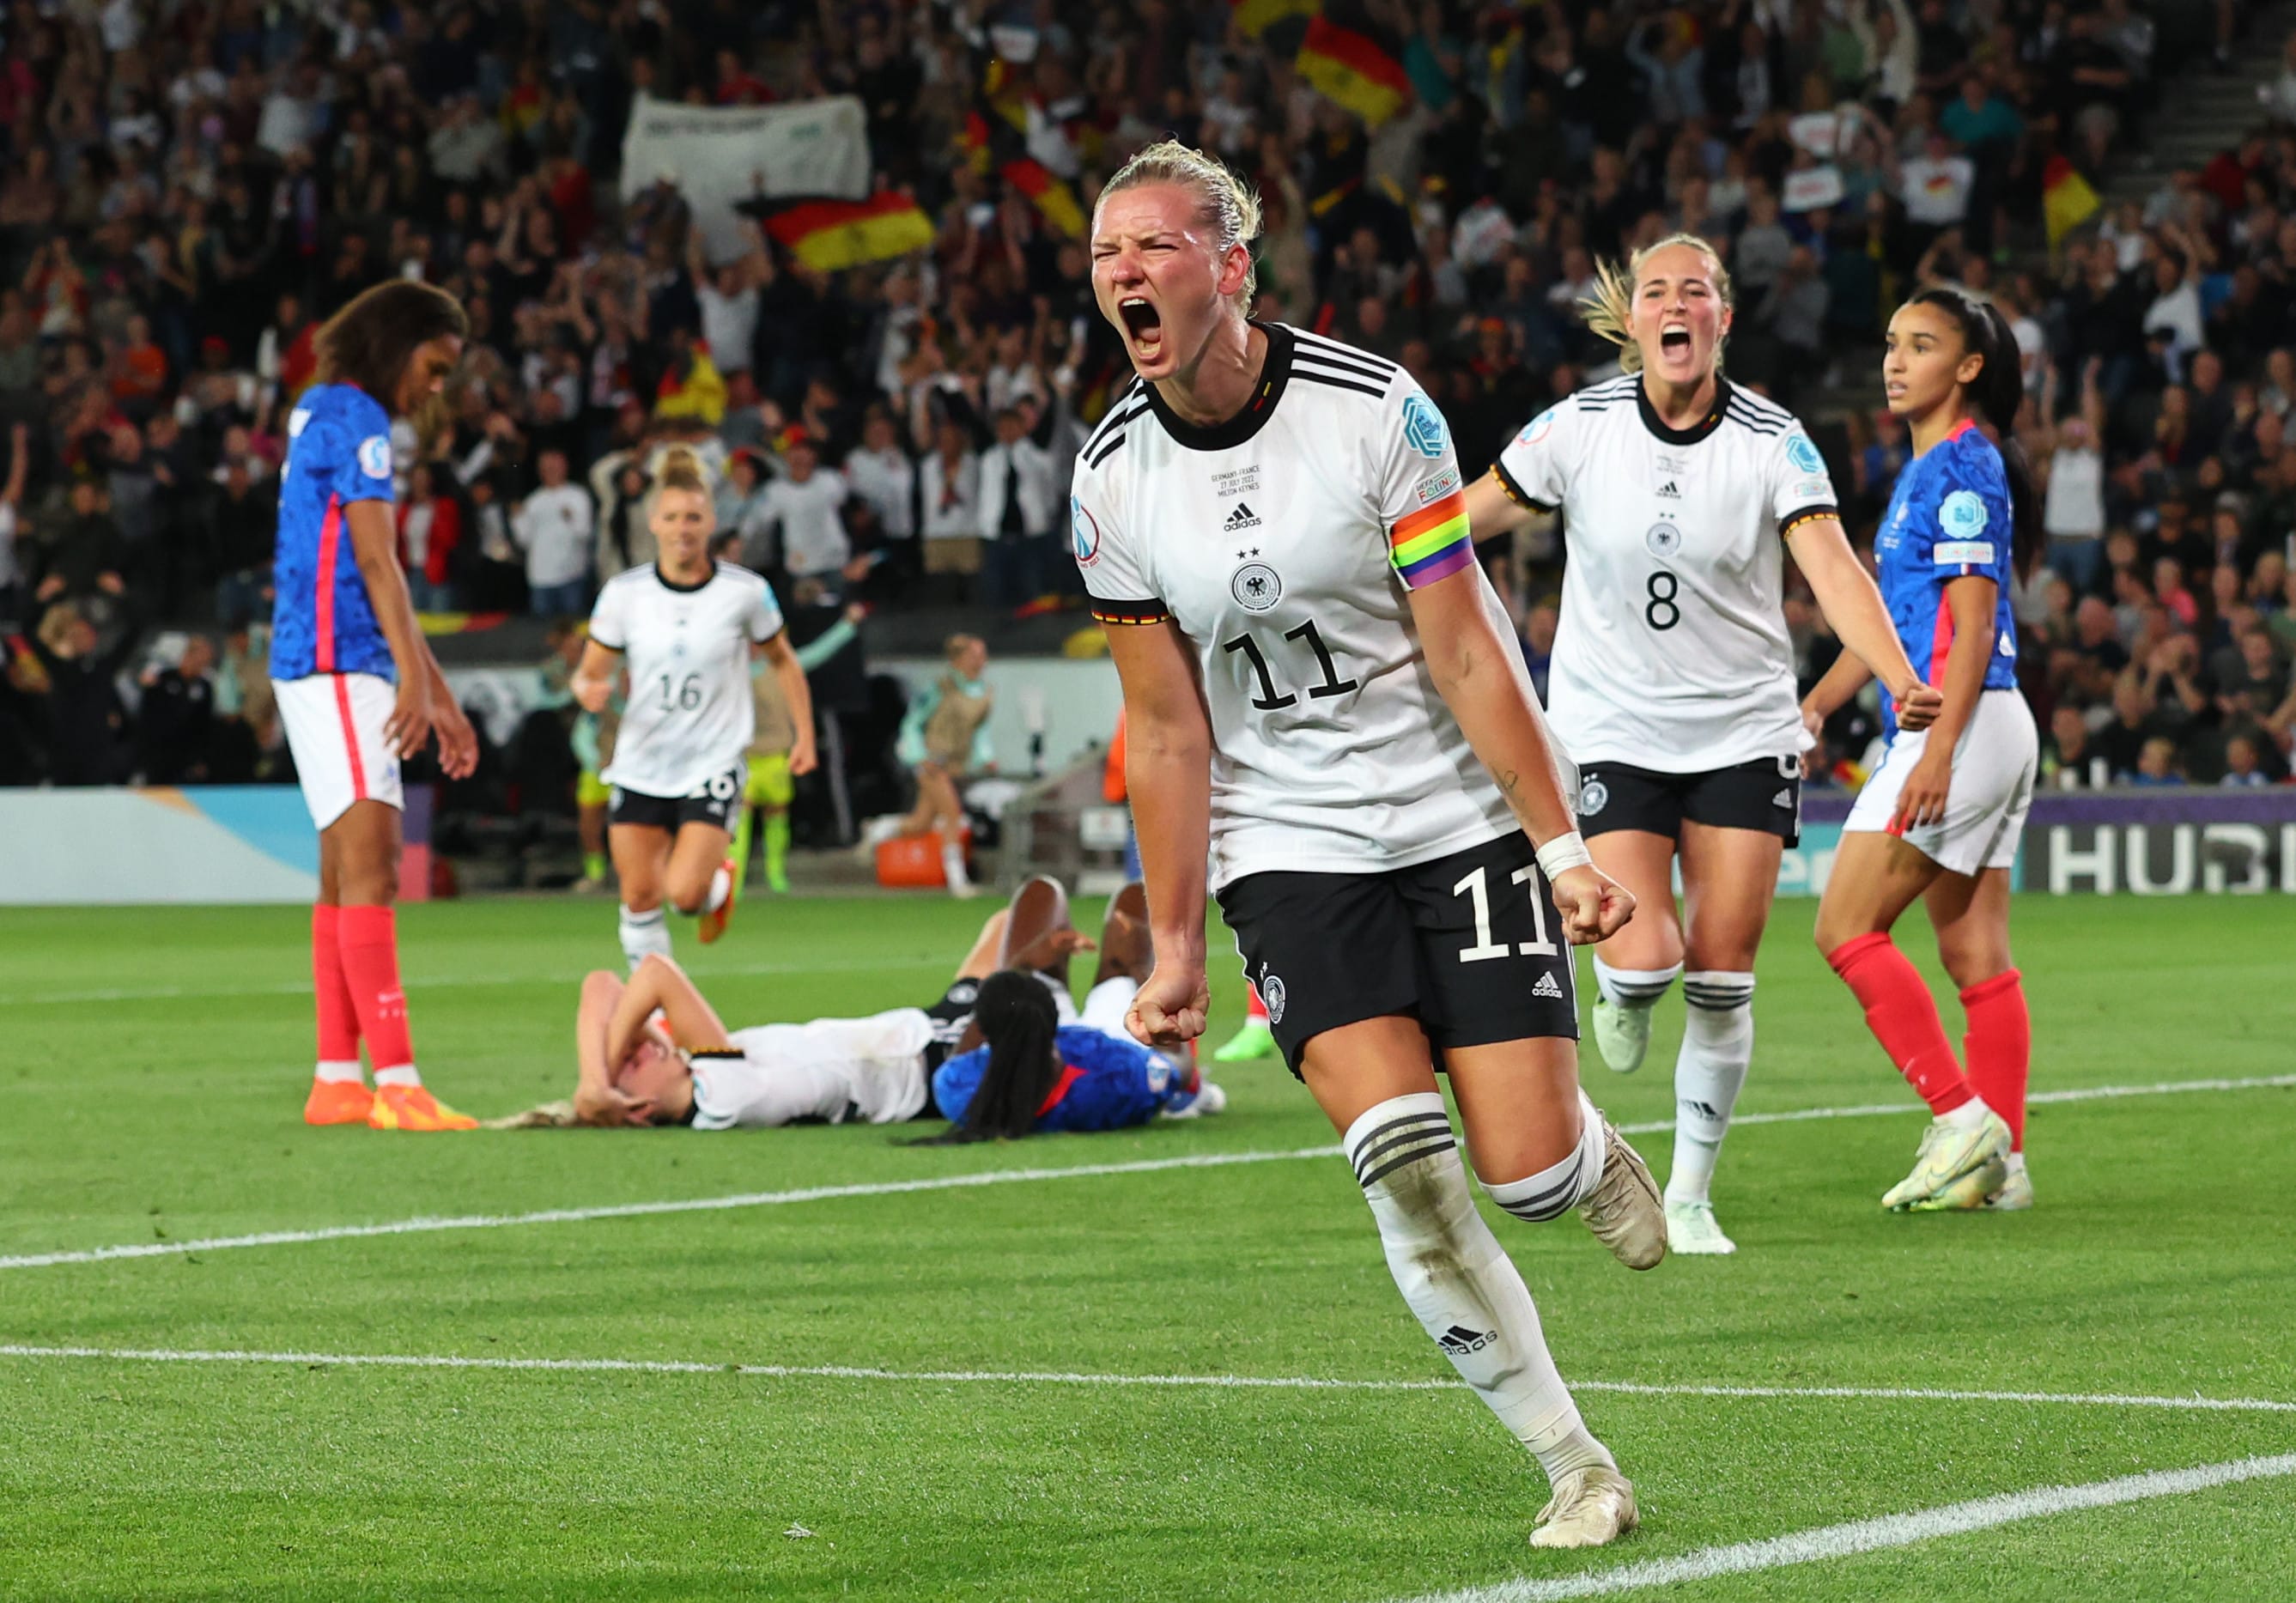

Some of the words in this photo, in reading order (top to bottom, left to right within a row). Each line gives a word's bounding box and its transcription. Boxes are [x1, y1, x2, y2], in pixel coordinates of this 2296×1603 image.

[1224, 517, 1261, 532] adidas
[1646, 571, 1680, 631] 8
[1222, 617, 1359, 711] 11
[659, 672, 702, 713] 16
[1453, 862, 1558, 963] 11
[1532, 987, 1563, 999] adidas
[1443, 1330, 1497, 1356] didas
